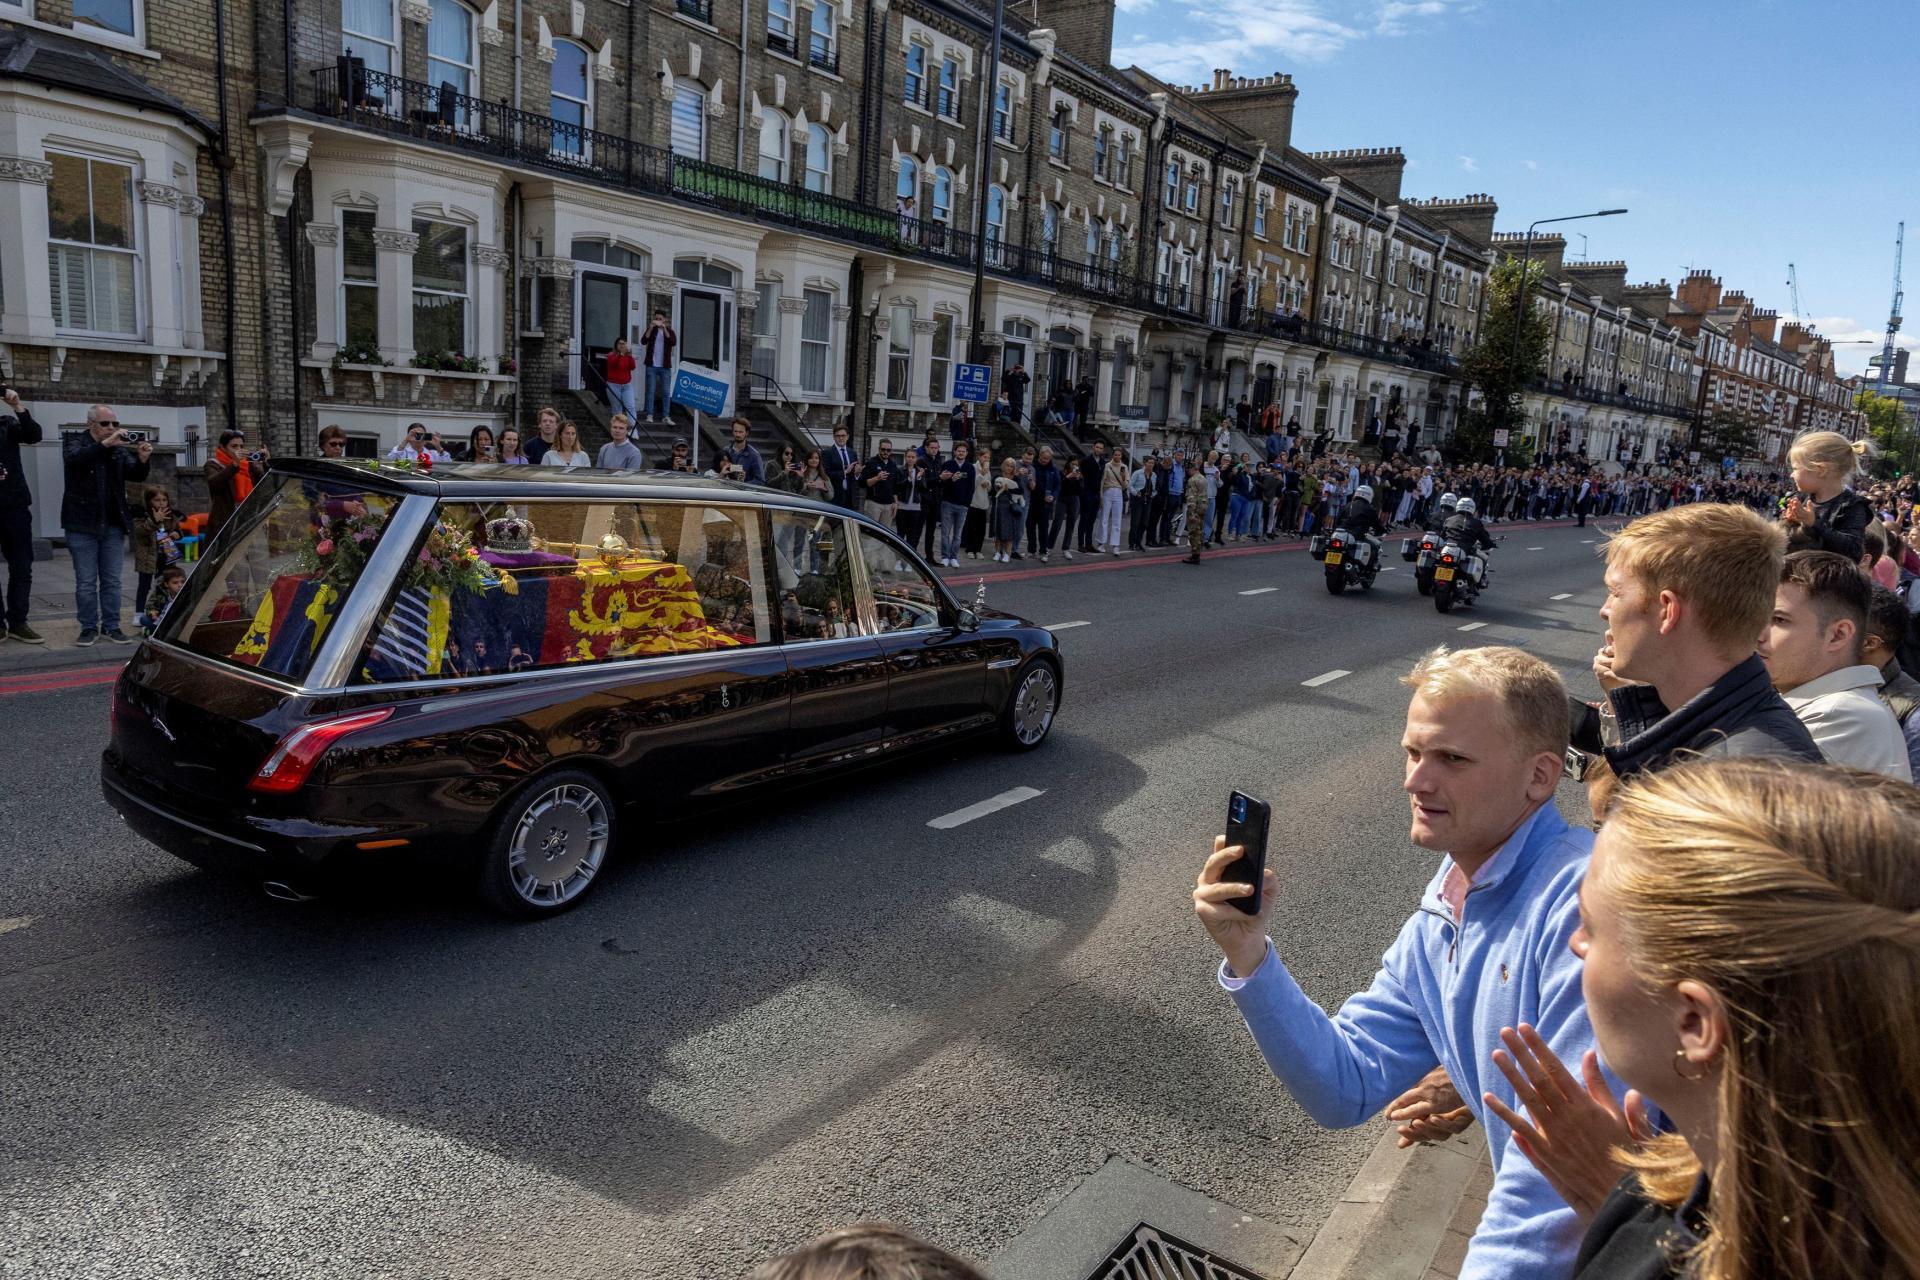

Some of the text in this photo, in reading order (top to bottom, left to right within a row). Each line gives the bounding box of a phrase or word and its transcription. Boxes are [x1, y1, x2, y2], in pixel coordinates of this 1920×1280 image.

[959, 366, 970, 380] P
[691, 381, 723, 396] OpenRent
[964, 385, 985, 393] marked
